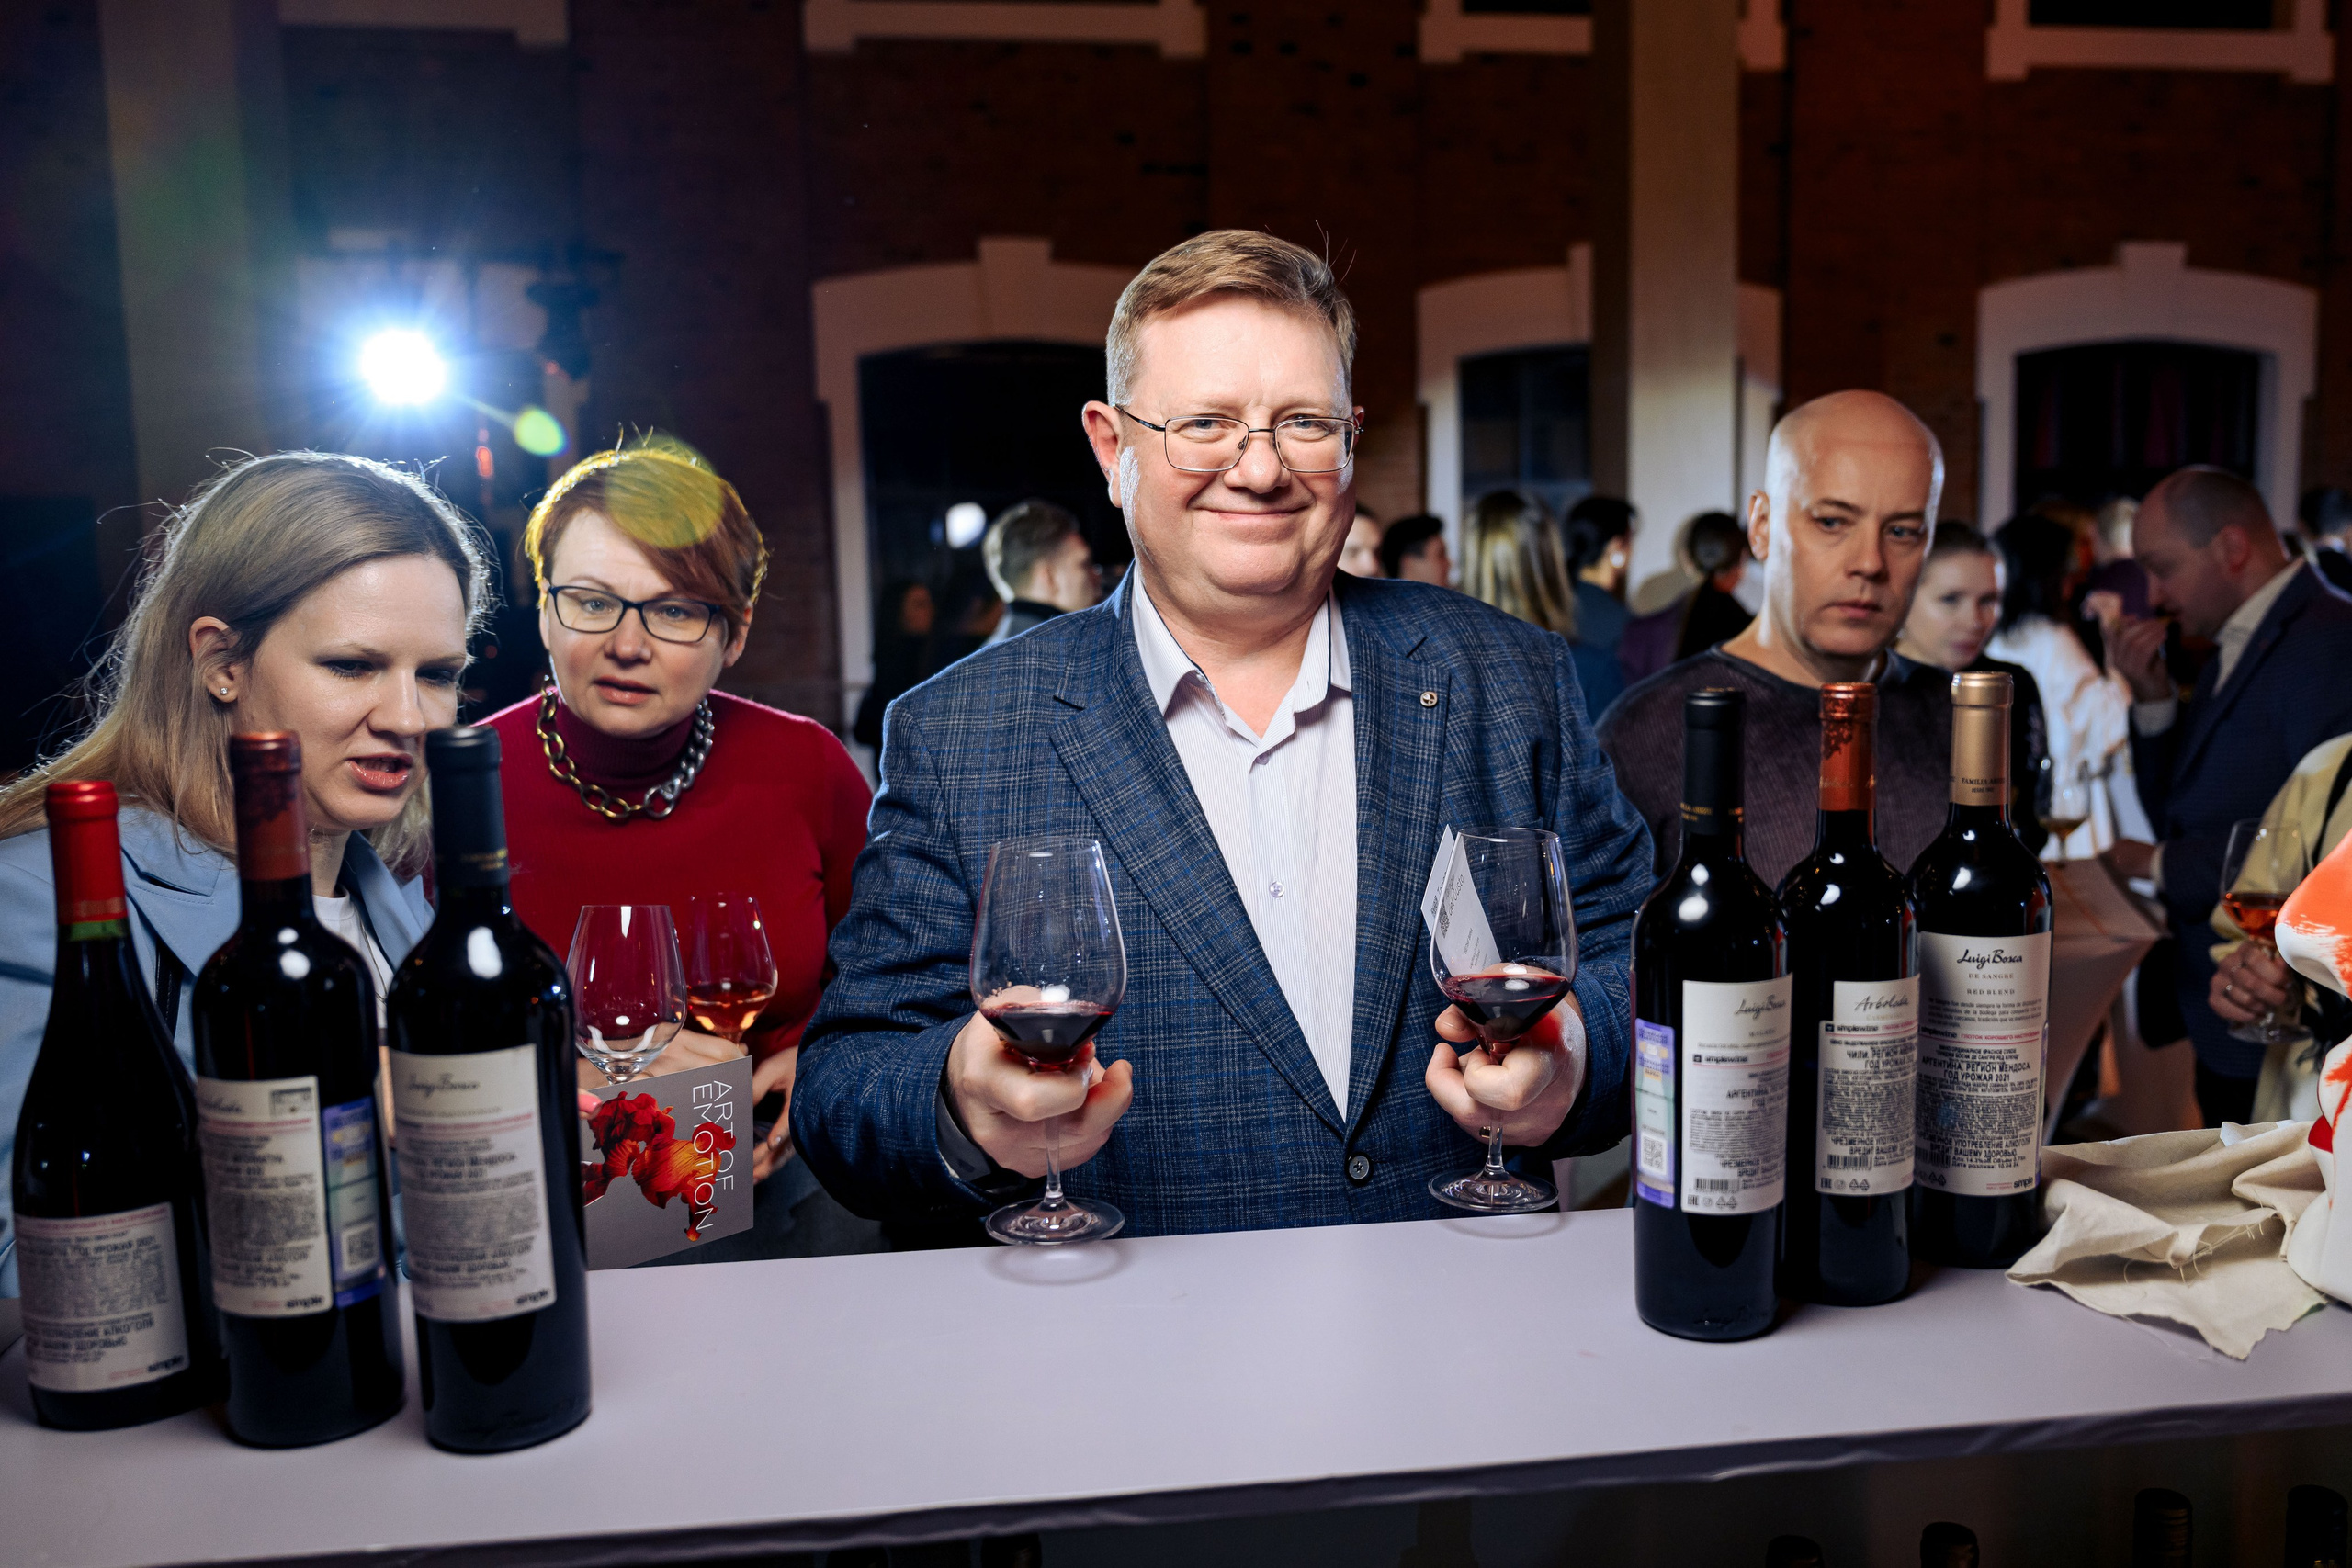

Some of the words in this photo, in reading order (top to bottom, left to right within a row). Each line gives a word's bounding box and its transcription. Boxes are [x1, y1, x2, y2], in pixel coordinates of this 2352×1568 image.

[1957, 949, 1991, 970] Luigi
[1991, 949, 2022, 963] Bosca
[1735, 998, 1765, 1020] Luigi
[1966, 1062, 1998, 1072] РЕГИОН
[1998, 1062, 2030, 1073] МЕНДОСА
[1943, 1070, 1959, 1082] ГОД
[1961, 1072, 1993, 1081] УРОЖАЯ
[1996, 1074, 2010, 1082] 2021
[713, 1079, 734, 1138] ART
[1831, 1136, 1874, 1145] ЧРЕЗМЕРНОЕ
[1954, 1139, 2003, 1148] УПОТРЕБЛЕНИЕ
[2005, 1136, 2030, 1147] АЛКОГОЛЯ
[1849, 1145, 1874, 1155] ВРЕДИТ
[1954, 1148, 1982, 1156] ВАШЕМУ
[1984, 1148, 2017, 1157] ЗДОРОВЬЮ
[692, 1083, 715, 1231] EMOTION
[715, 1149, 734, 1190] OF
[2013, 1176, 2033, 1188] simple
